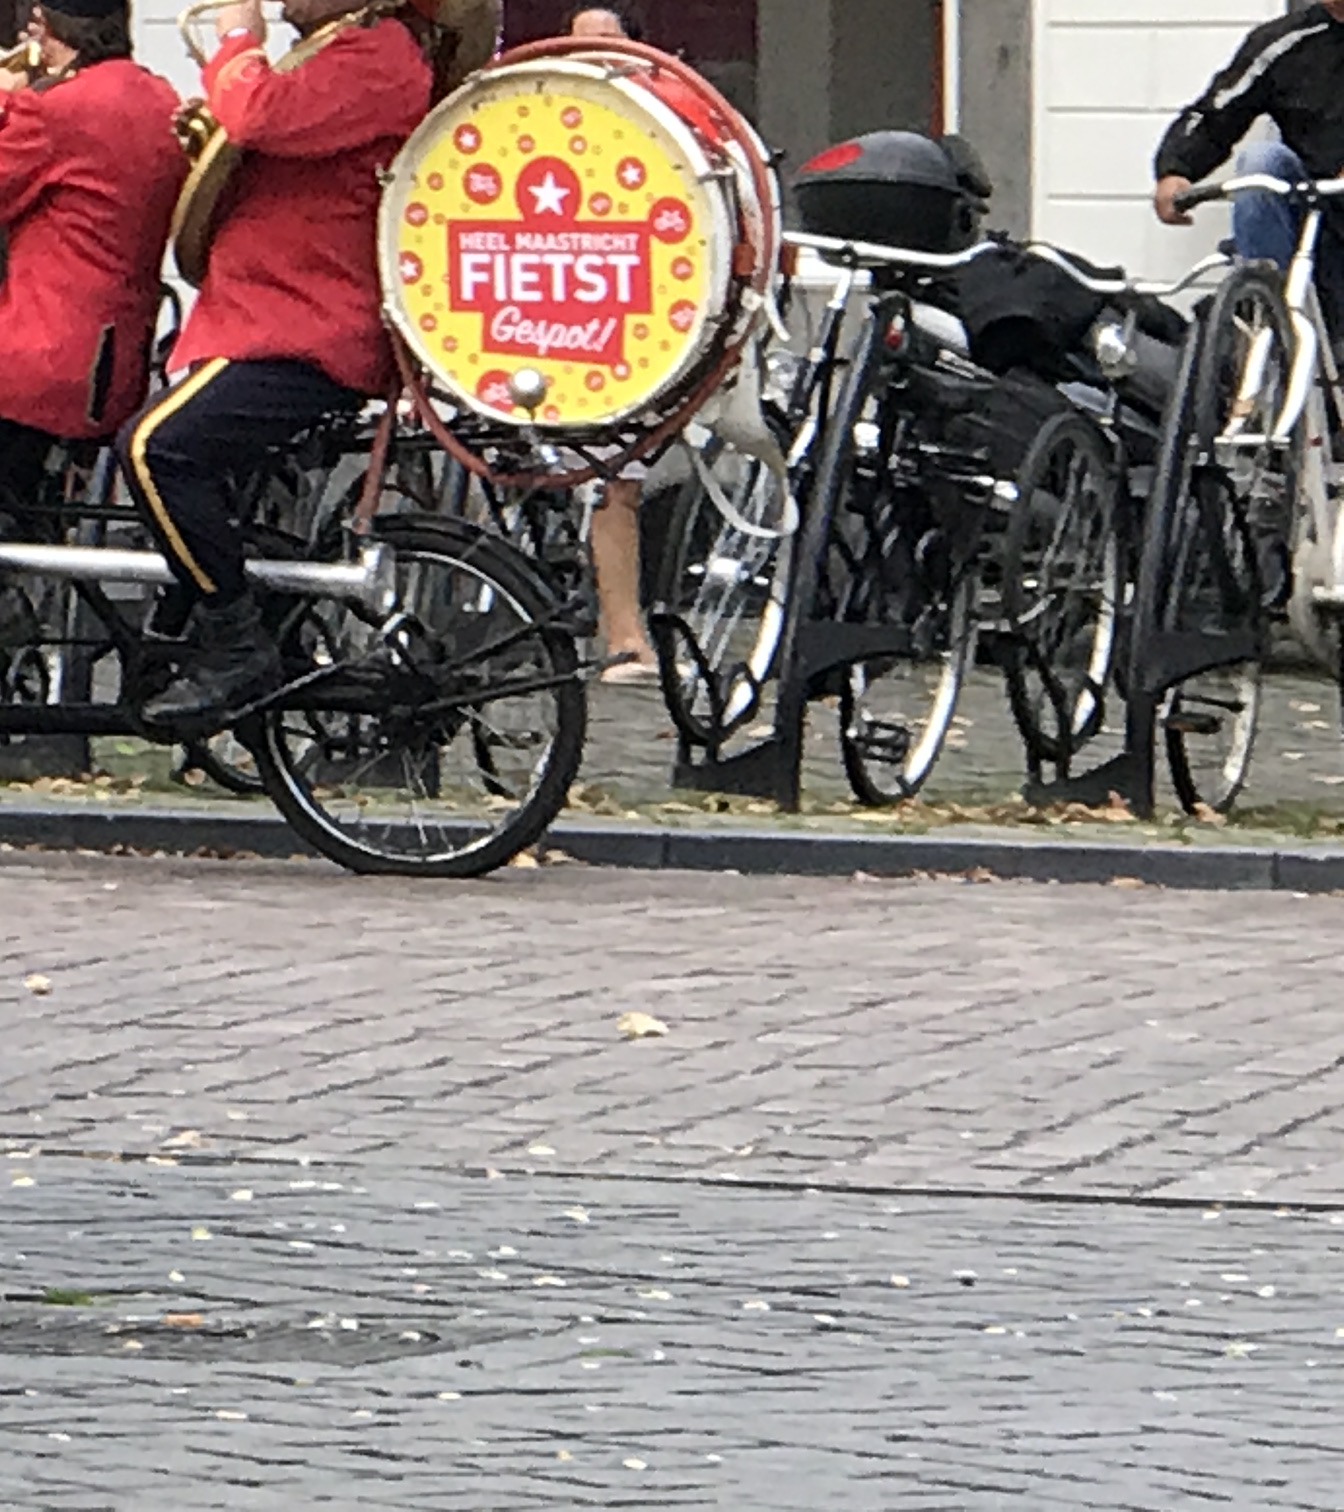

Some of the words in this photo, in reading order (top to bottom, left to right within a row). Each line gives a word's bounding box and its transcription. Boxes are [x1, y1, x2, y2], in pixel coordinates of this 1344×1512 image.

[459, 231, 510, 251] HEEL
[515, 232, 640, 252] MAASTRICHT
[460, 253, 641, 303] FIETST
[490, 305, 617, 356] Gespot!
